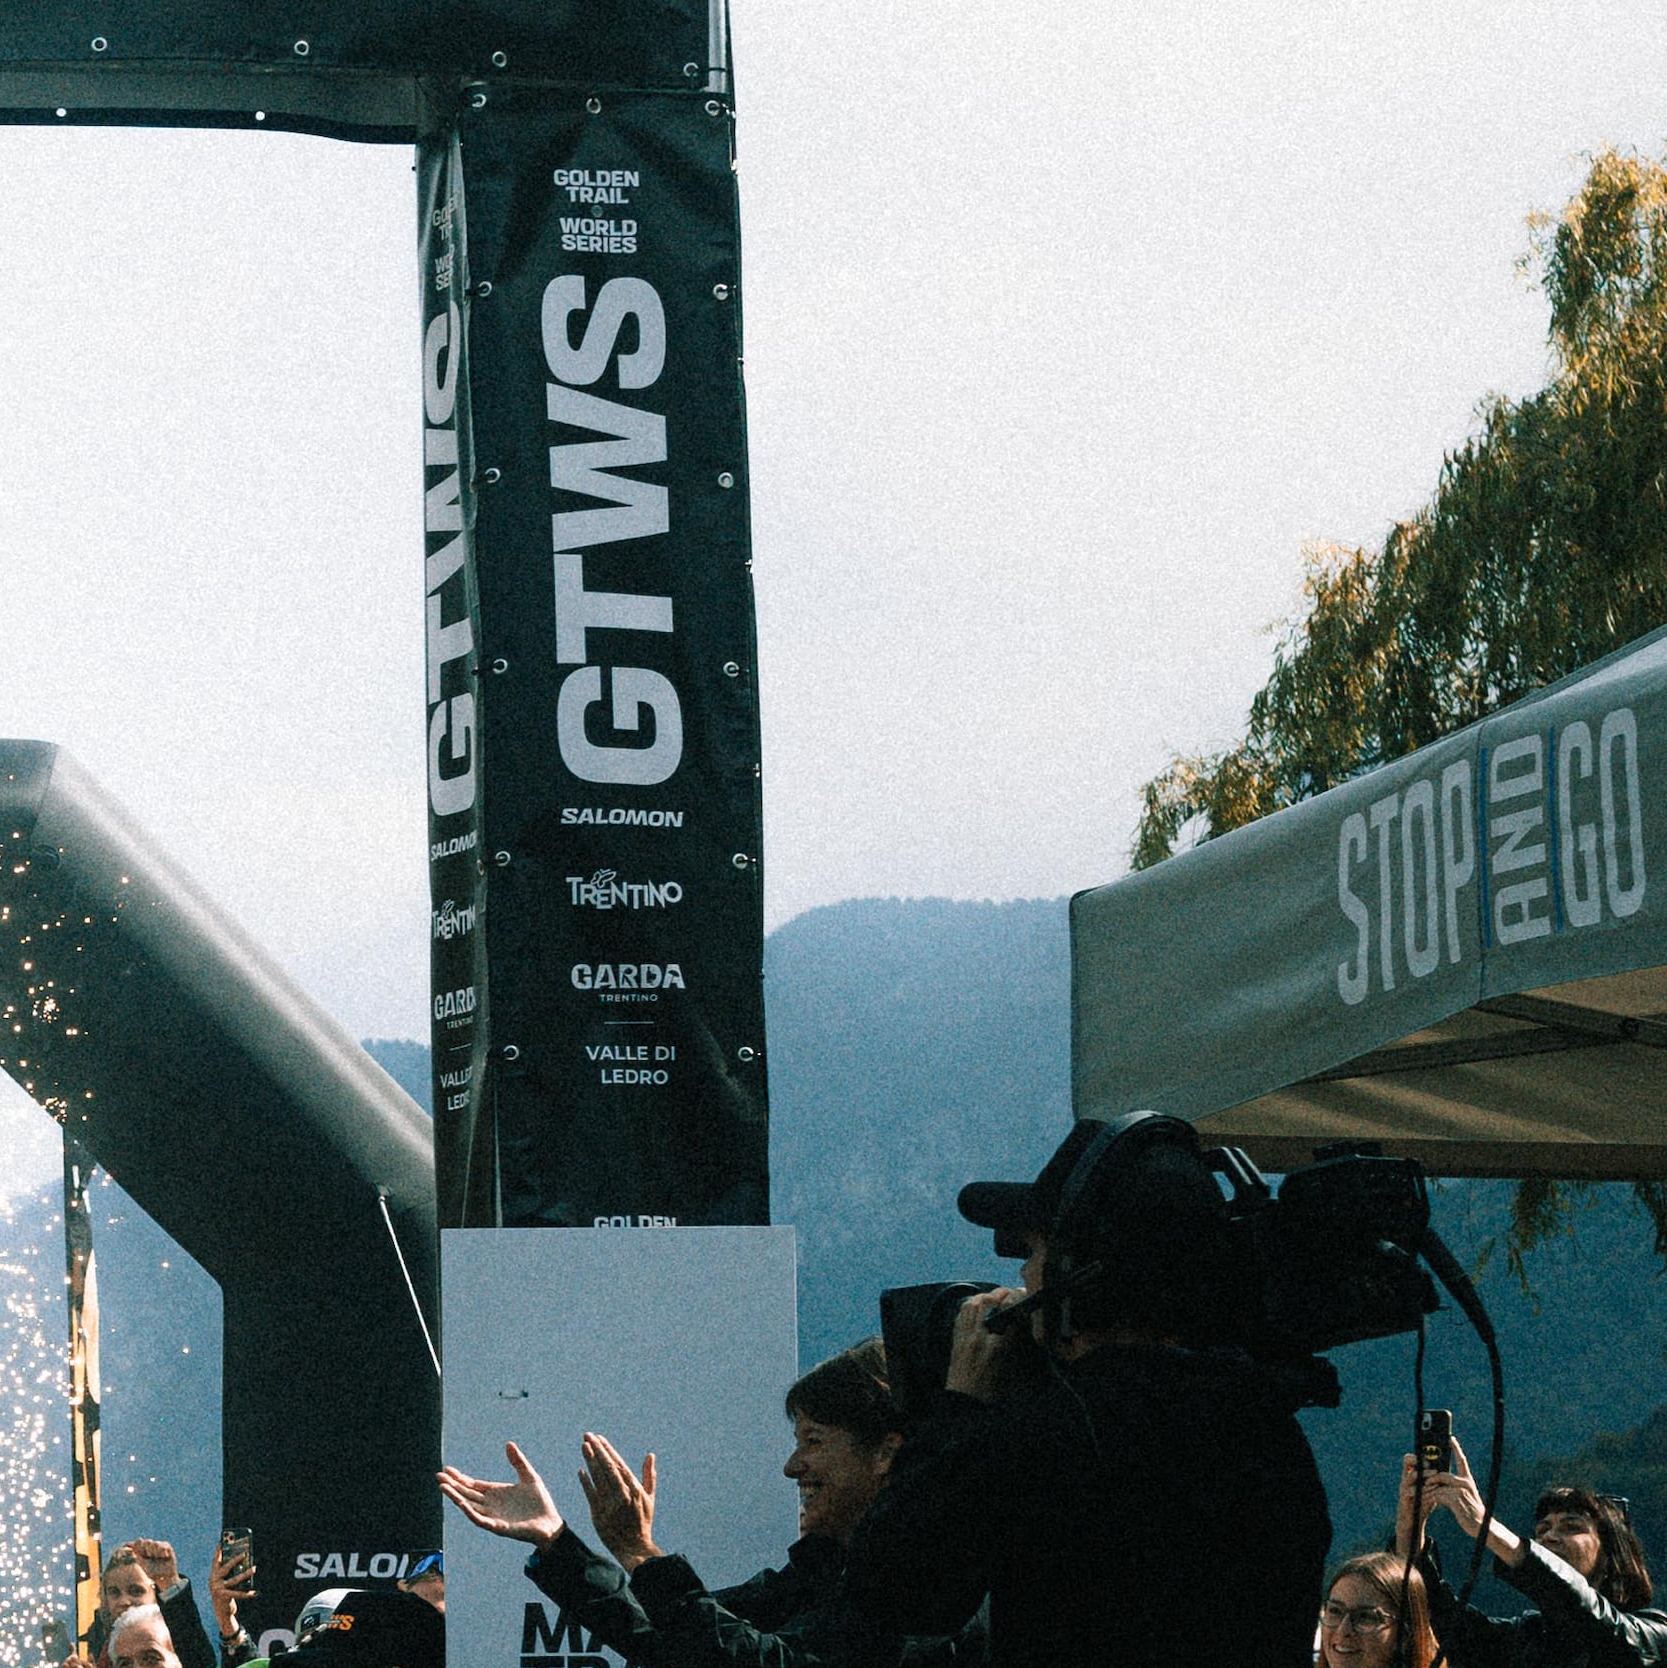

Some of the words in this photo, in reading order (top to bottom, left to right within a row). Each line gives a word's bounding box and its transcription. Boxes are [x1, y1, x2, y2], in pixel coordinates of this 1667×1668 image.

[553, 168, 639, 188] GOLDEN
[566, 186, 629, 204] TRAIL
[559, 217, 638, 238] WORLD
[561, 234, 637, 254] SERIES
[540, 274, 683, 785] GTWS
[560, 807, 684, 828] SALOMON
[1338, 760, 1473, 1005] STOP
[1490, 734, 1551, 946] AND
[1558, 708, 1646, 927] GO
[566, 873, 683, 910] TRENTINO
[570, 963, 686, 989] GARDA
[599, 993, 658, 1002] TRENTINO
[585, 1045, 649, 1061] VALLE
[654, 1045, 676, 1061] DI
[600, 1069, 668, 1085] LEDRO
[294, 1553, 409, 1579] SALO
